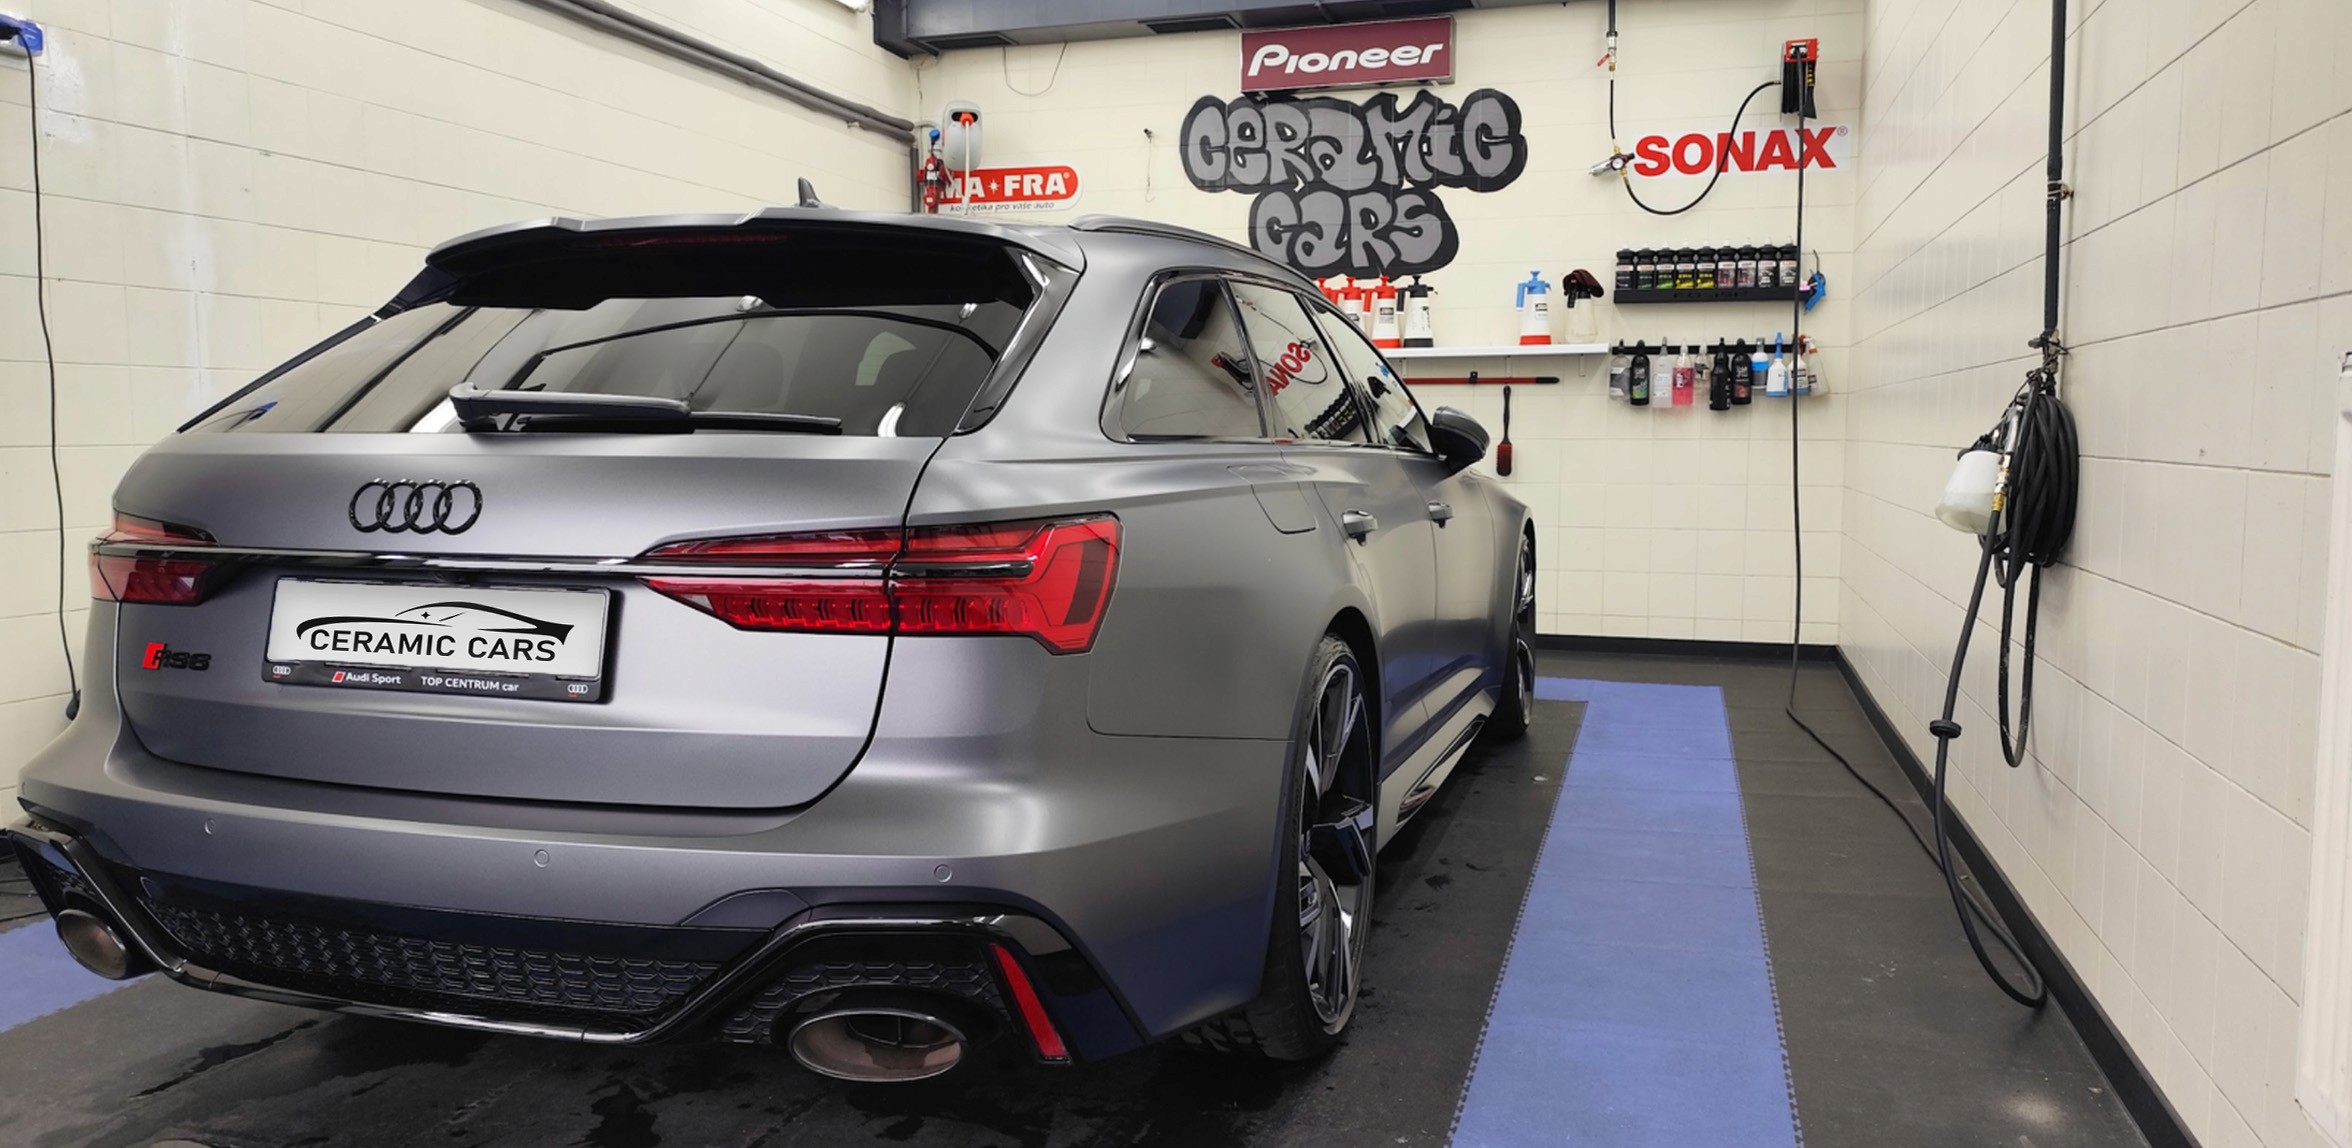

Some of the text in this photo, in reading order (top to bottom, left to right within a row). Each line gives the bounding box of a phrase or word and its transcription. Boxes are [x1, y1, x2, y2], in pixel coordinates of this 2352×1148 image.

[1248, 42, 1443, 77] Pioneer
[1633, 127, 1837, 177] SONAX
[940, 172, 1067, 199] MA FRA
[949, 203, 993, 212] koetika
[995, 203, 1010, 212] pro
[1033, 201, 1055, 209] auto
[309, 628, 557, 663] CERAMIC CARS
[345, 672, 401, 685] Audi Sport
[421, 675, 519, 692] TOP CENTRUM car
